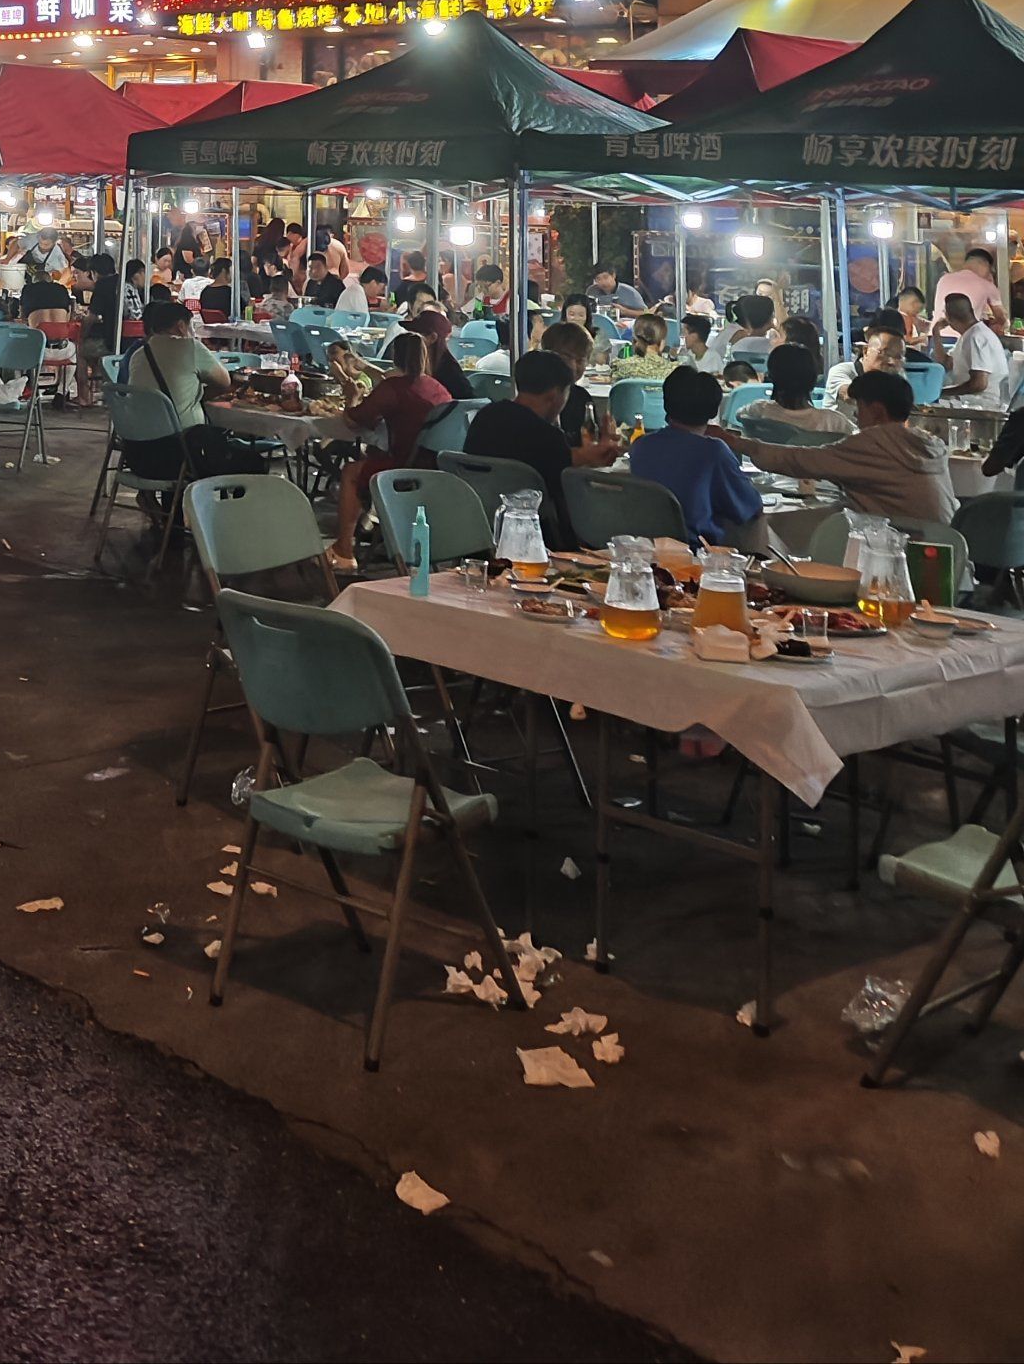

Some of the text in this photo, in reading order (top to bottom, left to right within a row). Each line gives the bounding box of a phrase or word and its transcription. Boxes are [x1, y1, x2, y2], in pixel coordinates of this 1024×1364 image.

[178, 10, 251, 35] 海鲜大咖
[256, 3, 337, 31] 特色烧烤
[306, 139, 447, 167] 畅享欢聚时刻
[802, 134, 1016, 171] 畅享欢聚时刻
